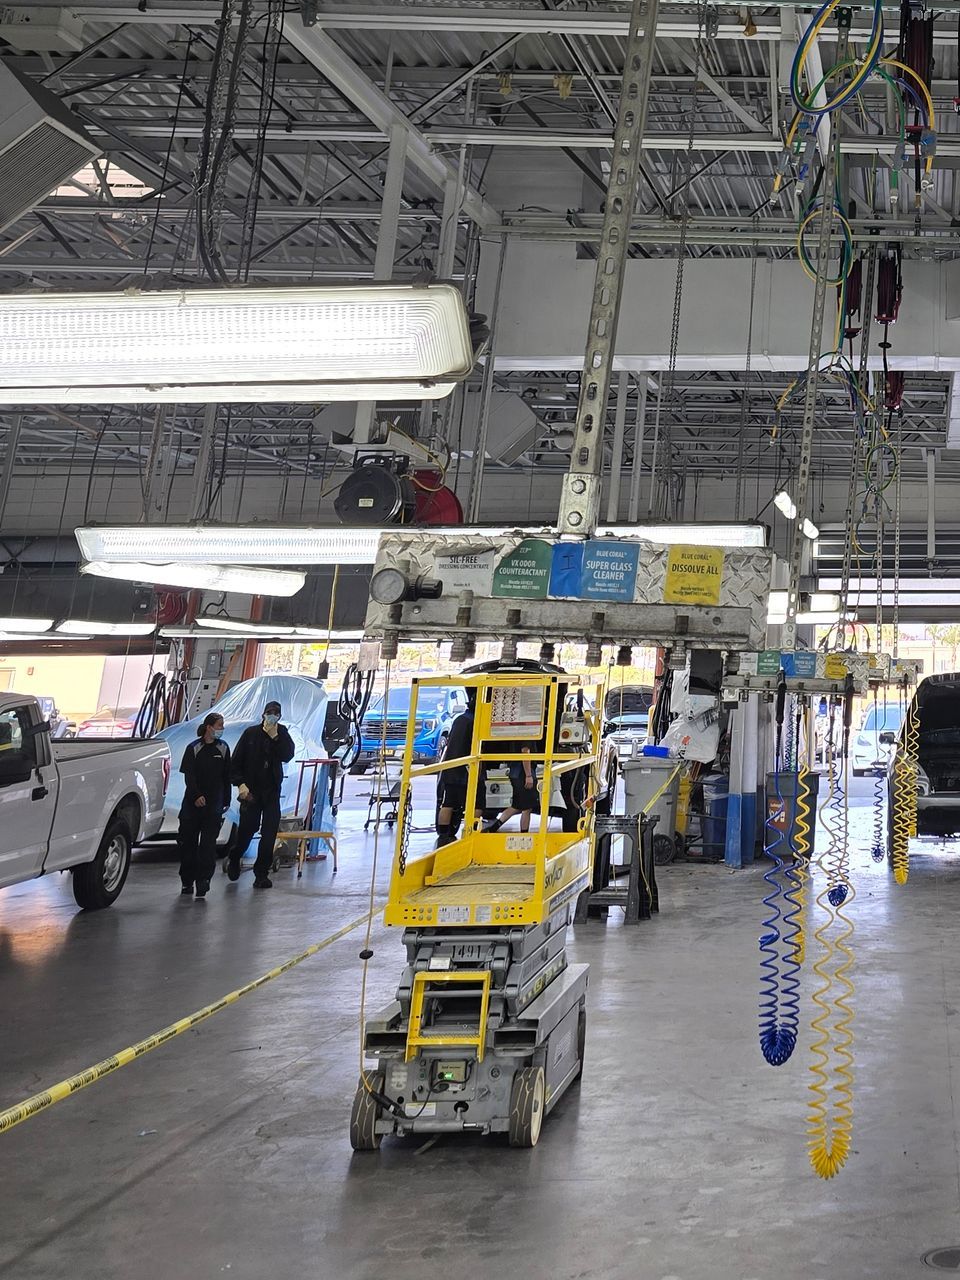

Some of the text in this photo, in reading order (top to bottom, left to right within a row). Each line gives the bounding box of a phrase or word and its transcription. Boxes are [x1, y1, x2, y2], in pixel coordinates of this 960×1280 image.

[596, 550, 609, 558] BLUE
[681, 553, 694, 561] BLUE
[449, 555, 478, 564] SIL-FREE
[511, 559, 537, 568] VX ODOR
[586, 560, 633, 571] SUPER GLASS
[671, 564, 719, 575] DISSOLVE ALL
[499, 567, 547, 577] COUNTERACTANT
[593, 570, 625, 581] CLEANER
[451, 945, 481, 959] 1491
